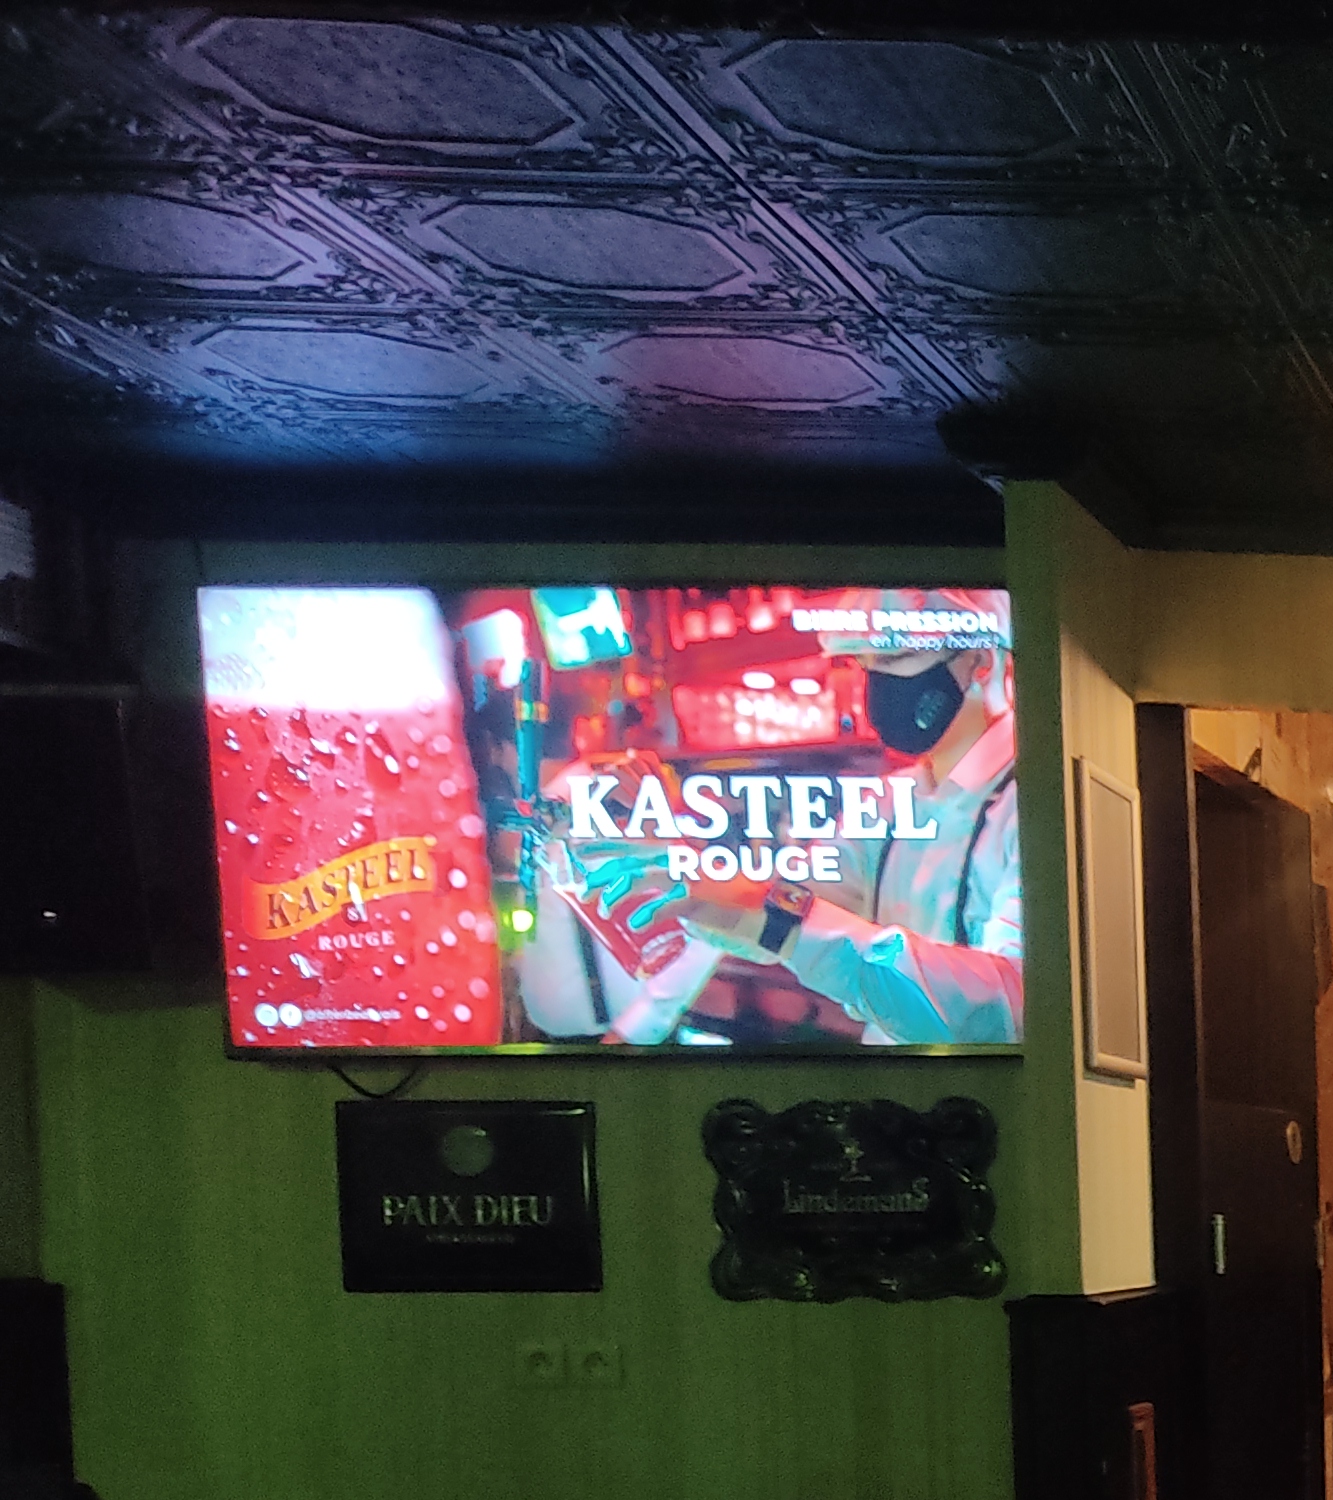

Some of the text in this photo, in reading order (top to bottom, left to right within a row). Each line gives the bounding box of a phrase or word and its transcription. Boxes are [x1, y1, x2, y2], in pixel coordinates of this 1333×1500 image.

[872, 610, 998, 632] PRESSION
[871, 635, 891, 648] en
[894, 634, 946, 651] happy
[947, 634, 992, 649] hours
[566, 774, 938, 840] KASTEEL
[666, 845, 842, 882] ROUGE
[266, 849, 427, 929] KASTEEL
[318, 931, 395, 951] ROUGE
[382, 1195, 553, 1226] PAIX DIEU
